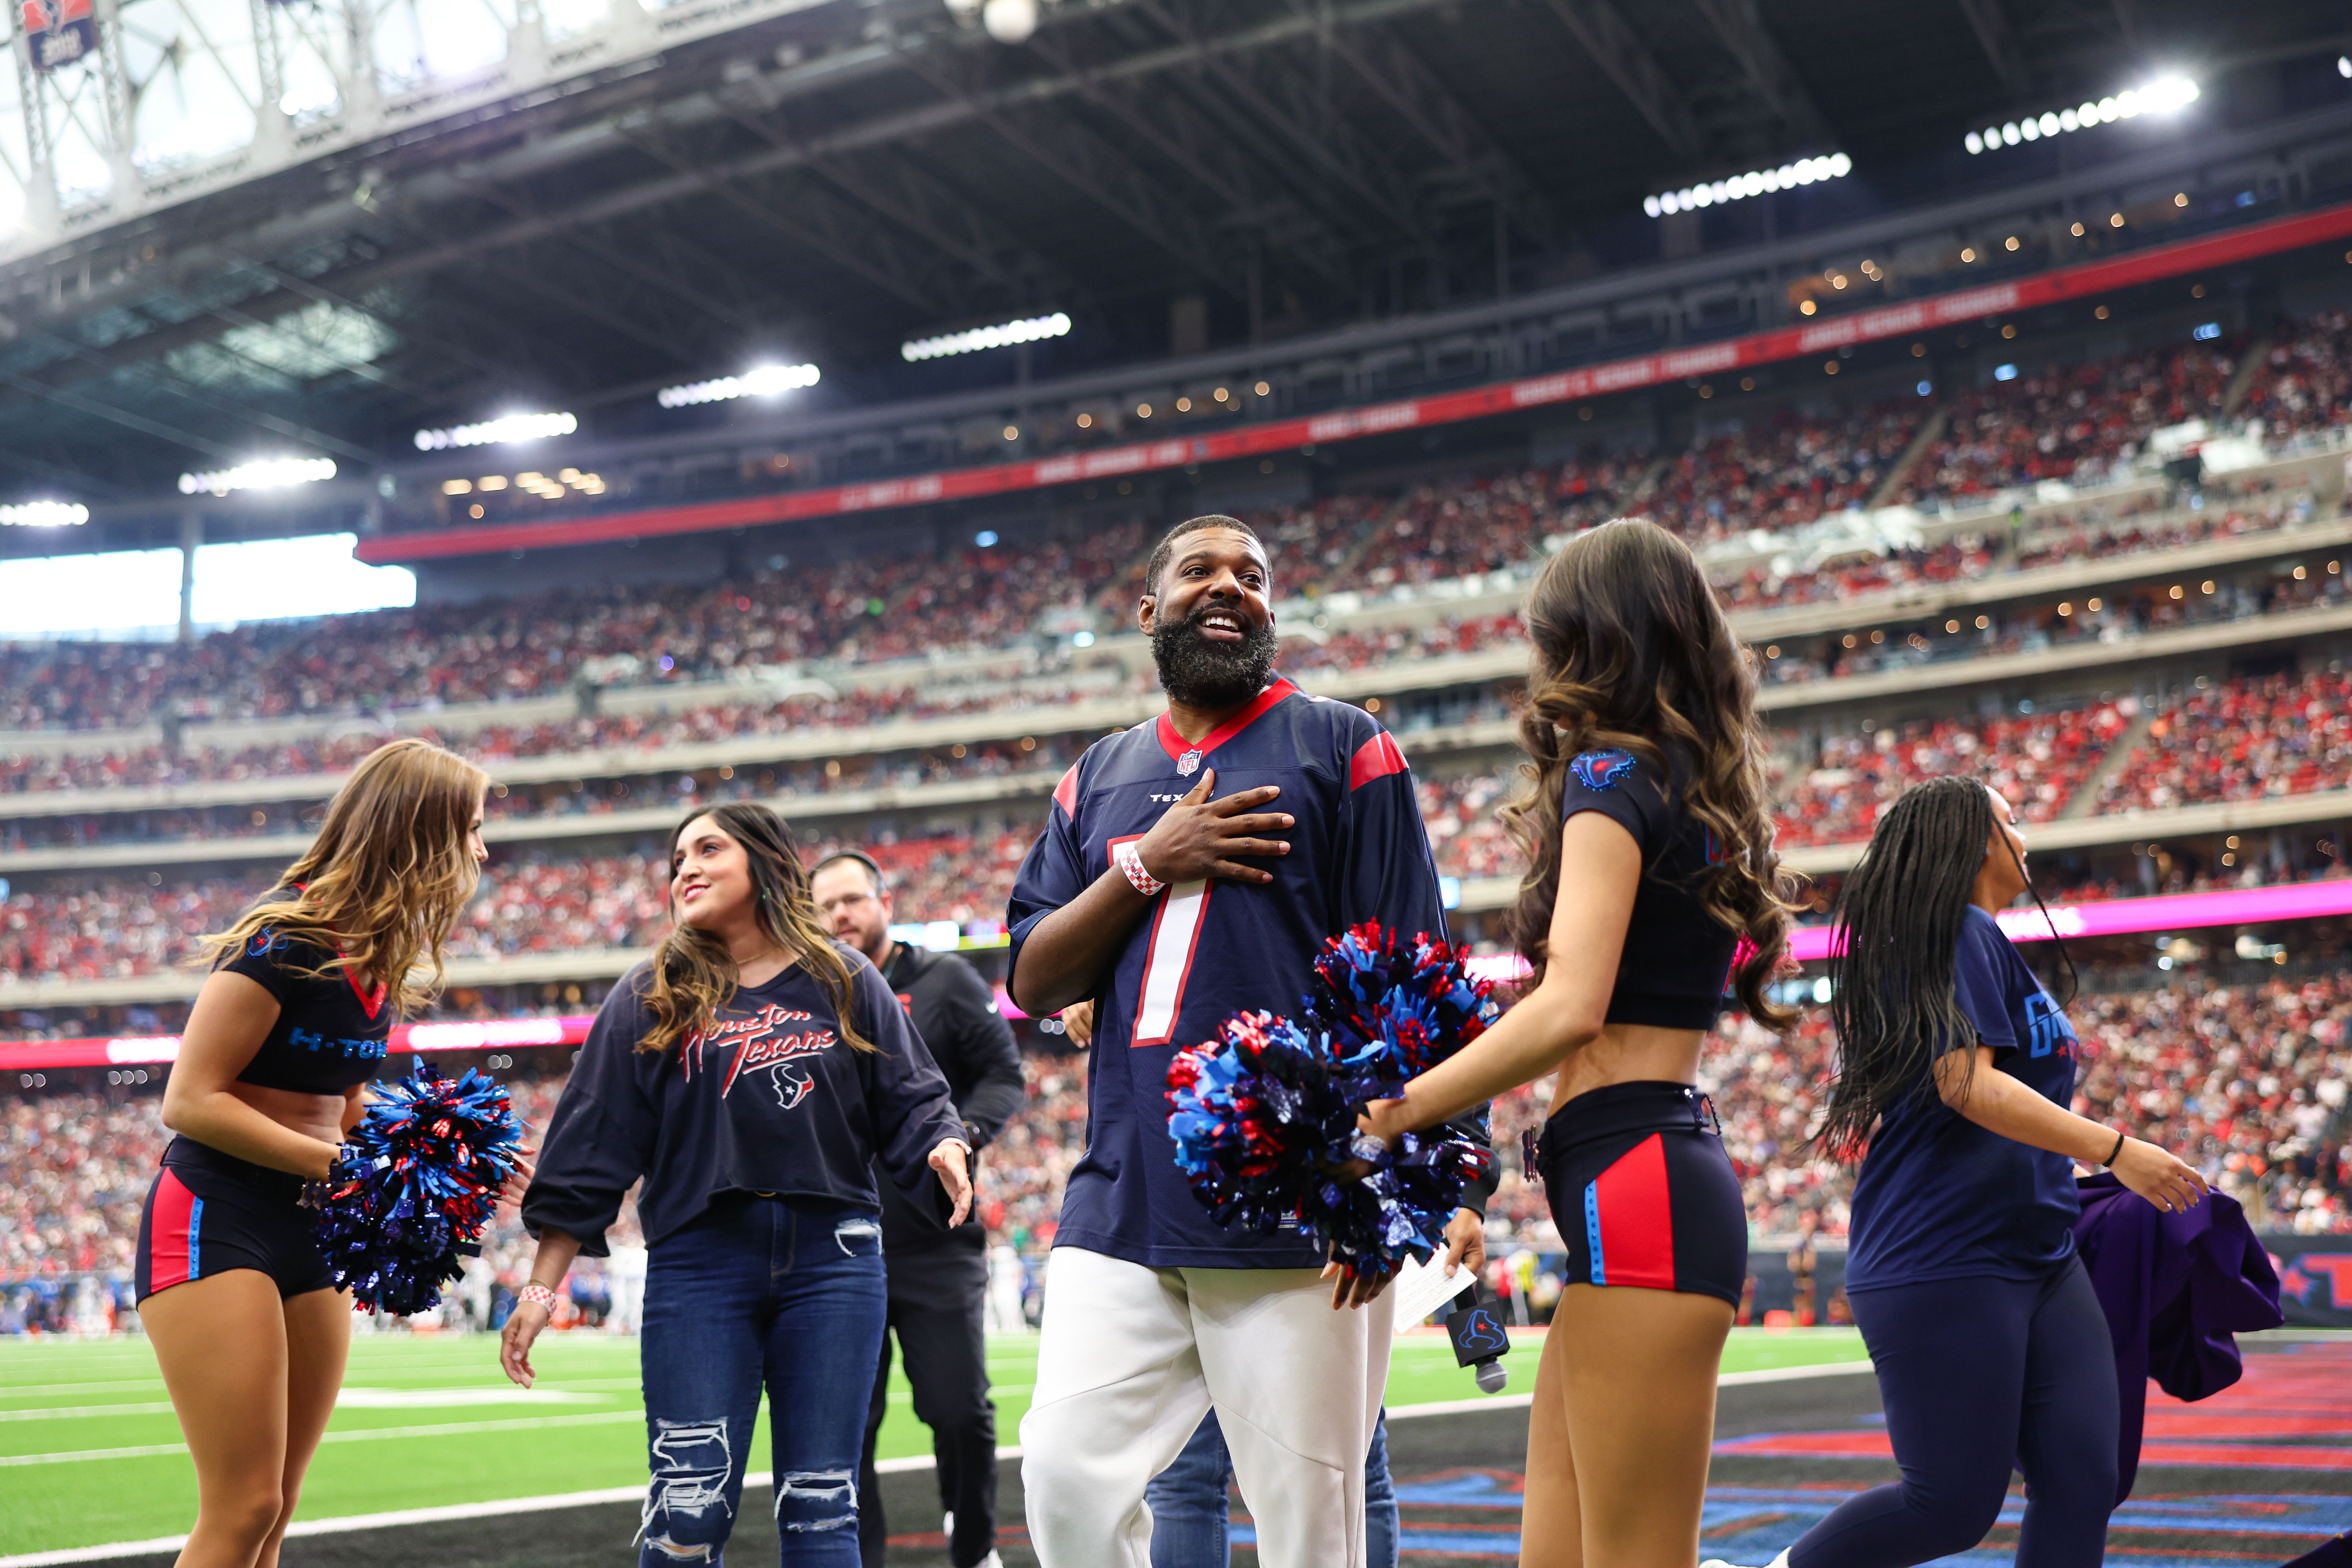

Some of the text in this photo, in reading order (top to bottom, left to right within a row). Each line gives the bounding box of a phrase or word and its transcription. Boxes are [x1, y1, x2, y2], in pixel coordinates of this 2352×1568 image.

[1180, 760, 1196, 771] NFL
[678, 1002, 813, 1083] Houston
[717, 1026, 838, 1099] Texans
